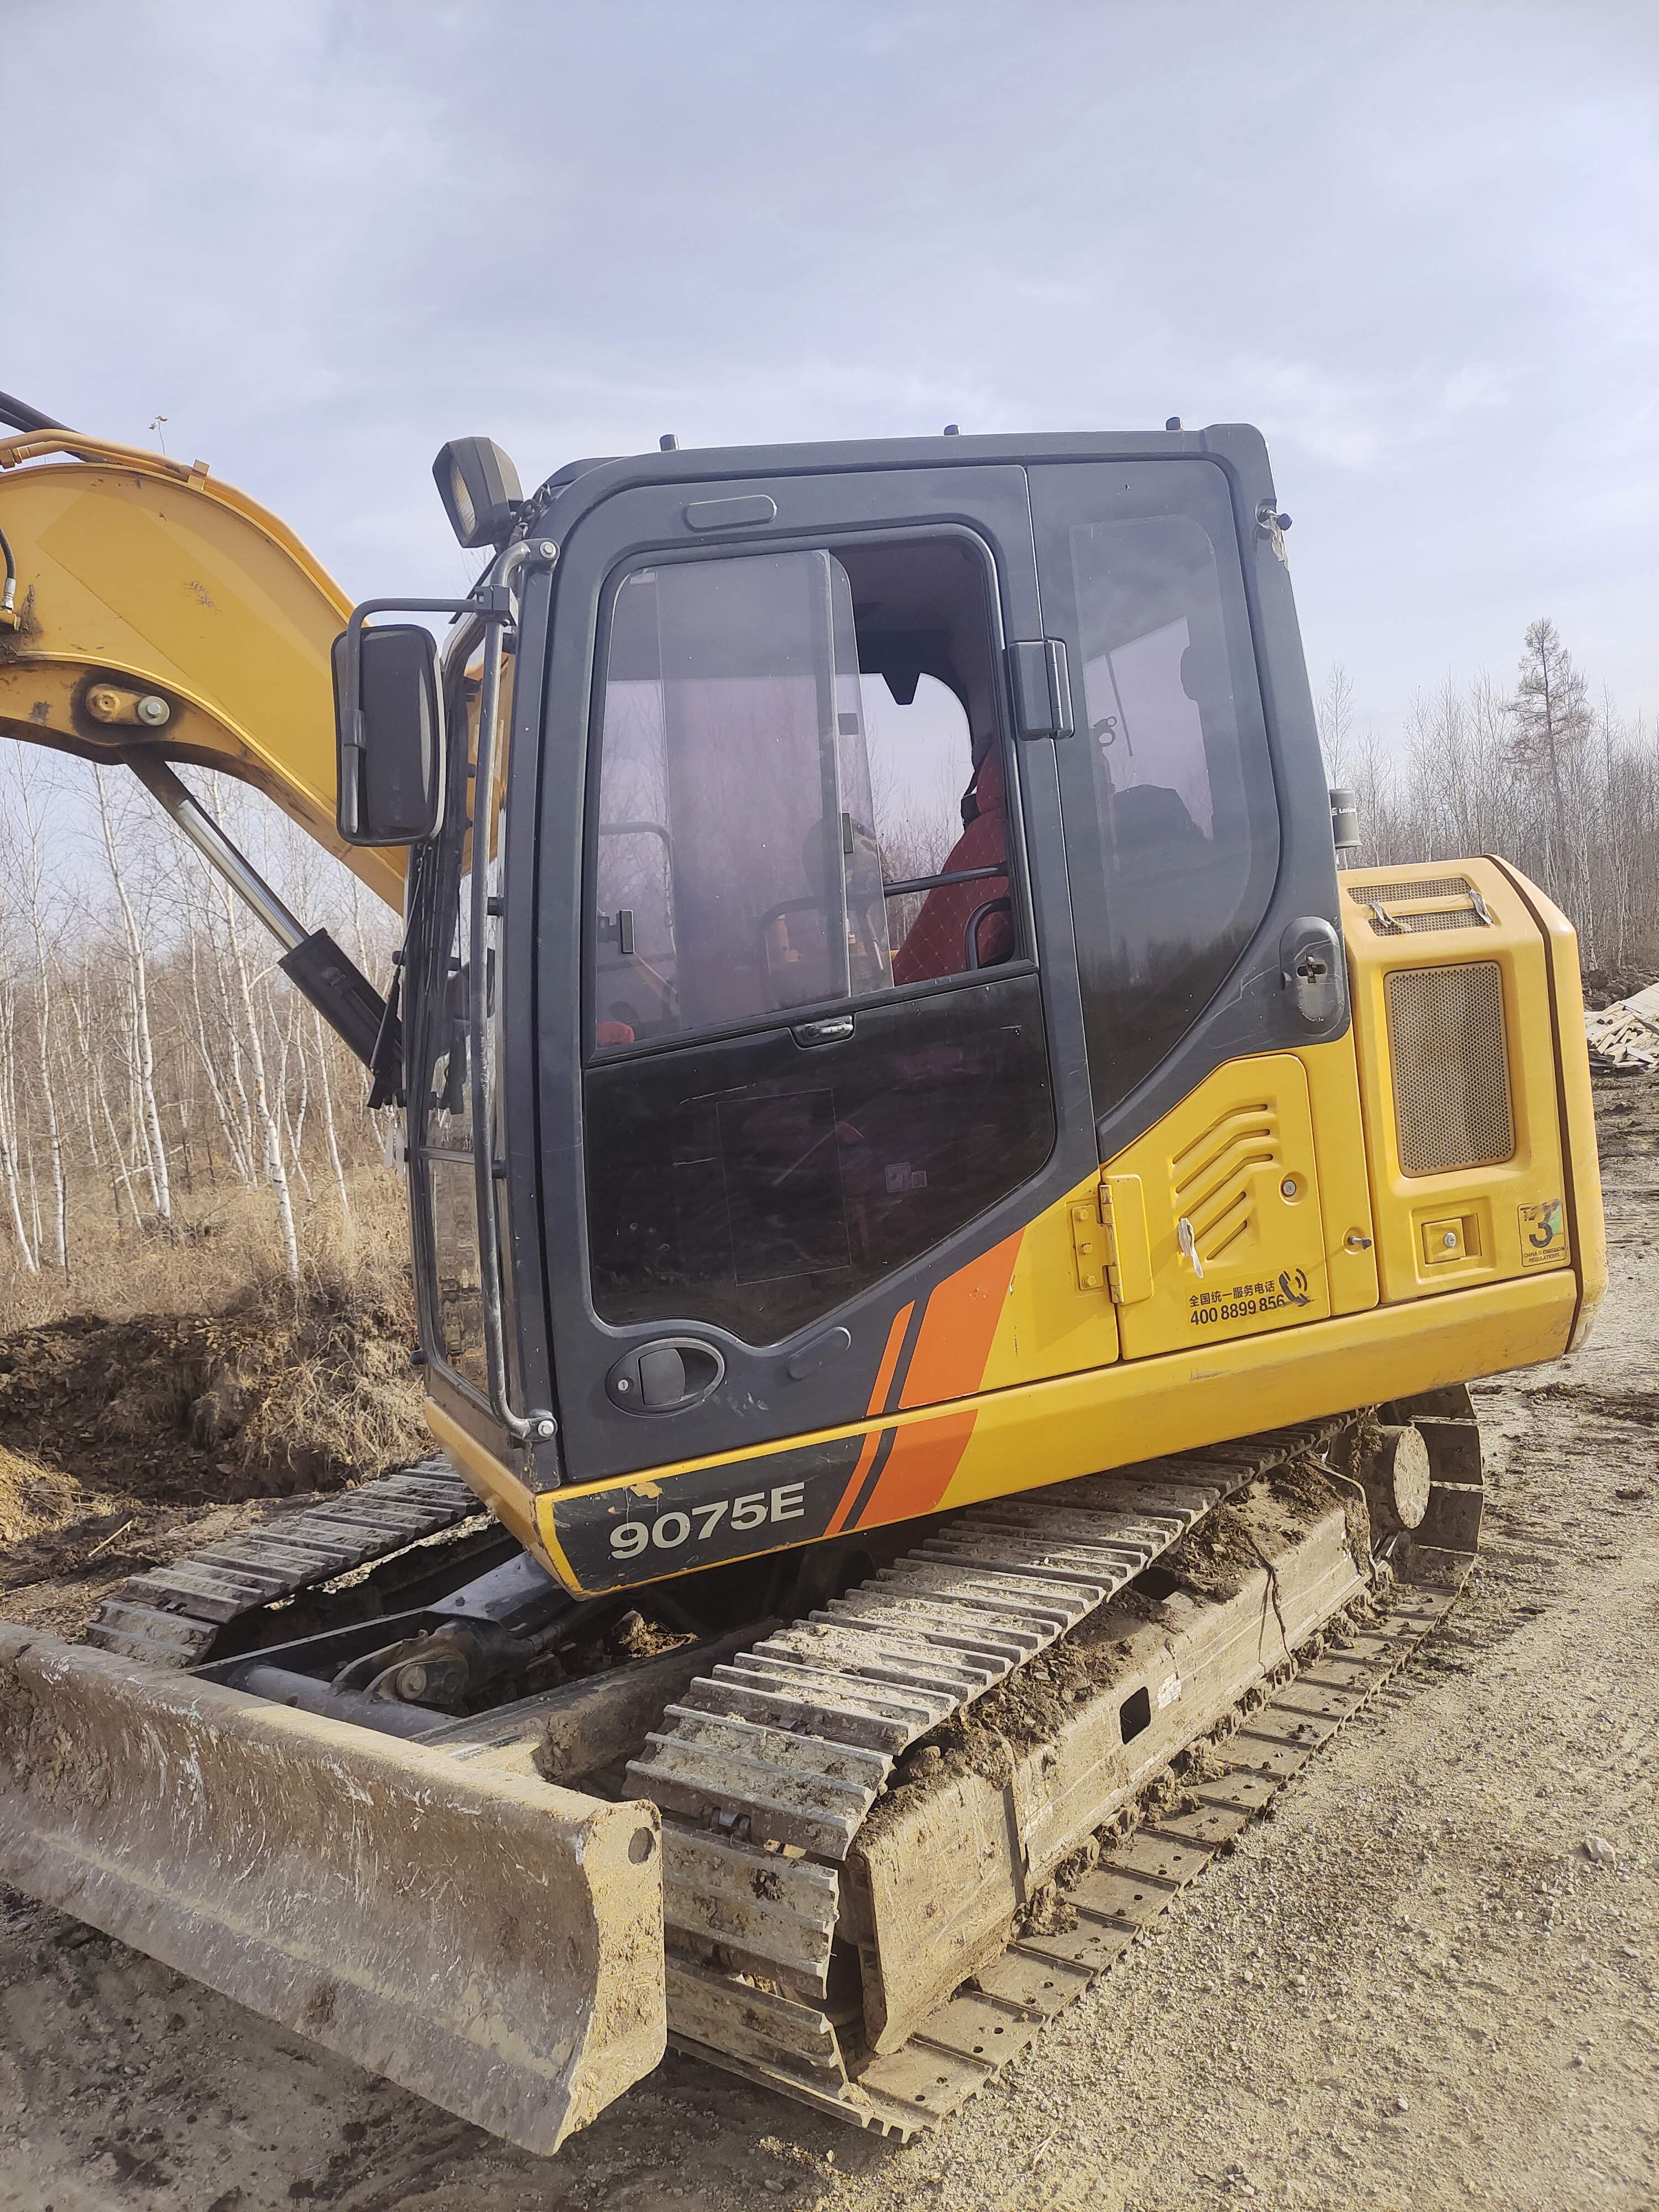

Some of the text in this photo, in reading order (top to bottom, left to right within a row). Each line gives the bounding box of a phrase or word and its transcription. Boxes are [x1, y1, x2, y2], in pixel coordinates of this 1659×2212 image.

[1189, 1280, 1275, 1307] 全国统一服务电话
[1191, 1294, 1285, 1325] 400 8899 856
[609, 1481, 805, 1559] 9075E
